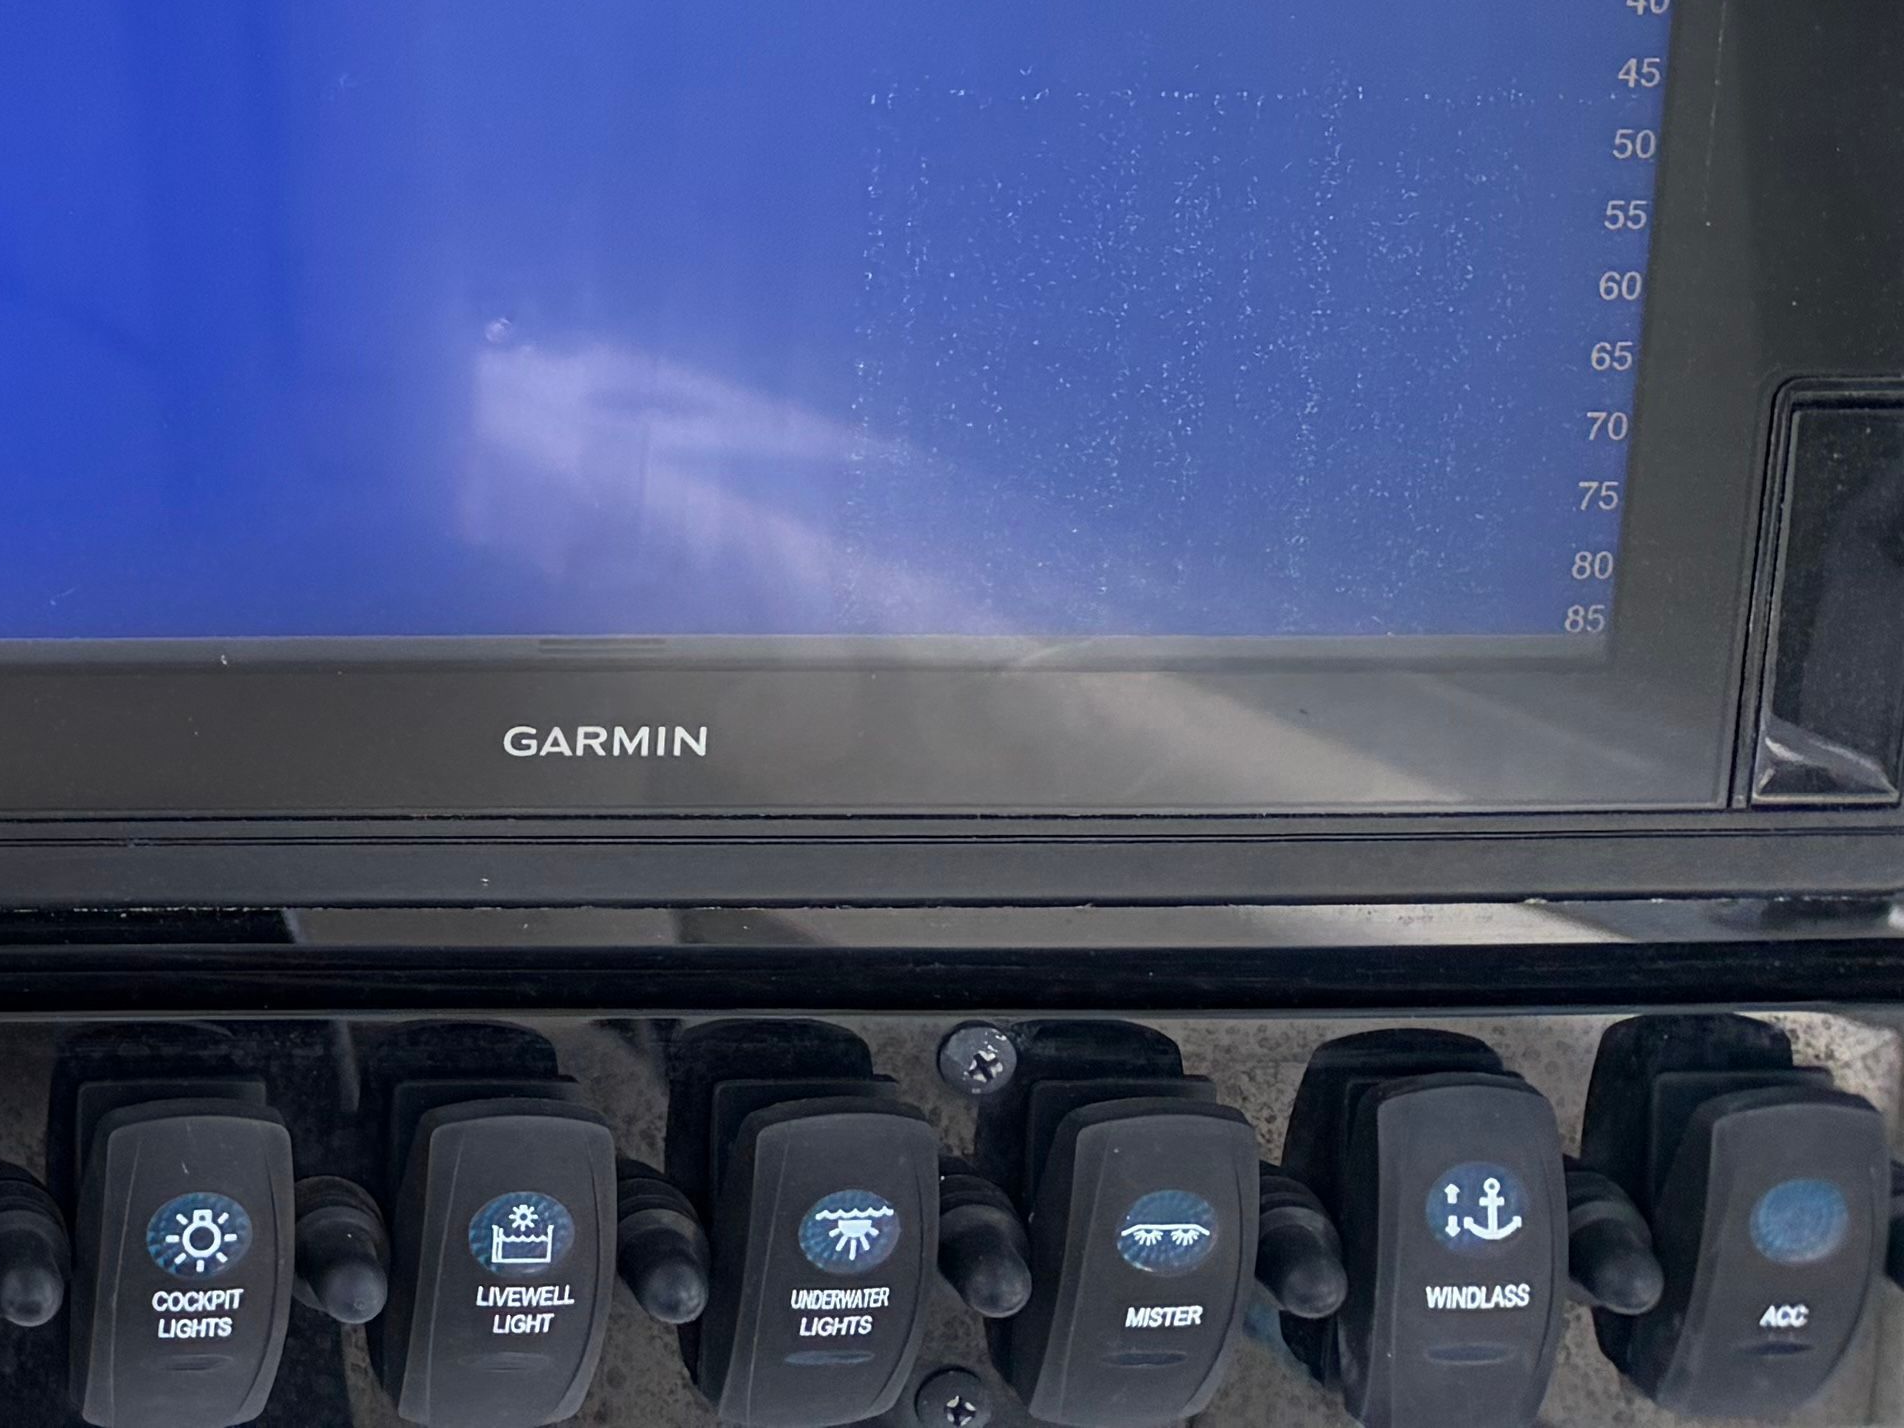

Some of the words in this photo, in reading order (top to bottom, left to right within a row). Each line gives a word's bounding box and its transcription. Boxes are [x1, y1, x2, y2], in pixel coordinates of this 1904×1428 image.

[1618, 57, 1661, 88] 45
[1612, 129, 1657, 160] 50
[1603, 200, 1649, 231] 55
[1598, 271, 1643, 302] 60
[1590, 341, 1633, 372] 65
[1585, 411, 1629, 442] 70
[1577, 481, 1619, 512] 75
[1571, 551, 1614, 582] 80
[1564, 604, 1606, 635] 85
[503, 726, 708, 757] GARMIN
[151, 1287, 244, 1314] COCKPIT
[475, 1285, 575, 1308] LIVEWELL
[790, 1286, 889, 1311] UNDERWATER
[1425, 1282, 1532, 1311] WINDLASS
[157, 1315, 234, 1340] LIGHTS
[492, 1312, 554, 1334] LIGHT
[799, 1314, 873, 1337] LIGHTS
[1124, 1304, 1204, 1329] MISTER
[1759, 1305, 1811, 1328] ACC
